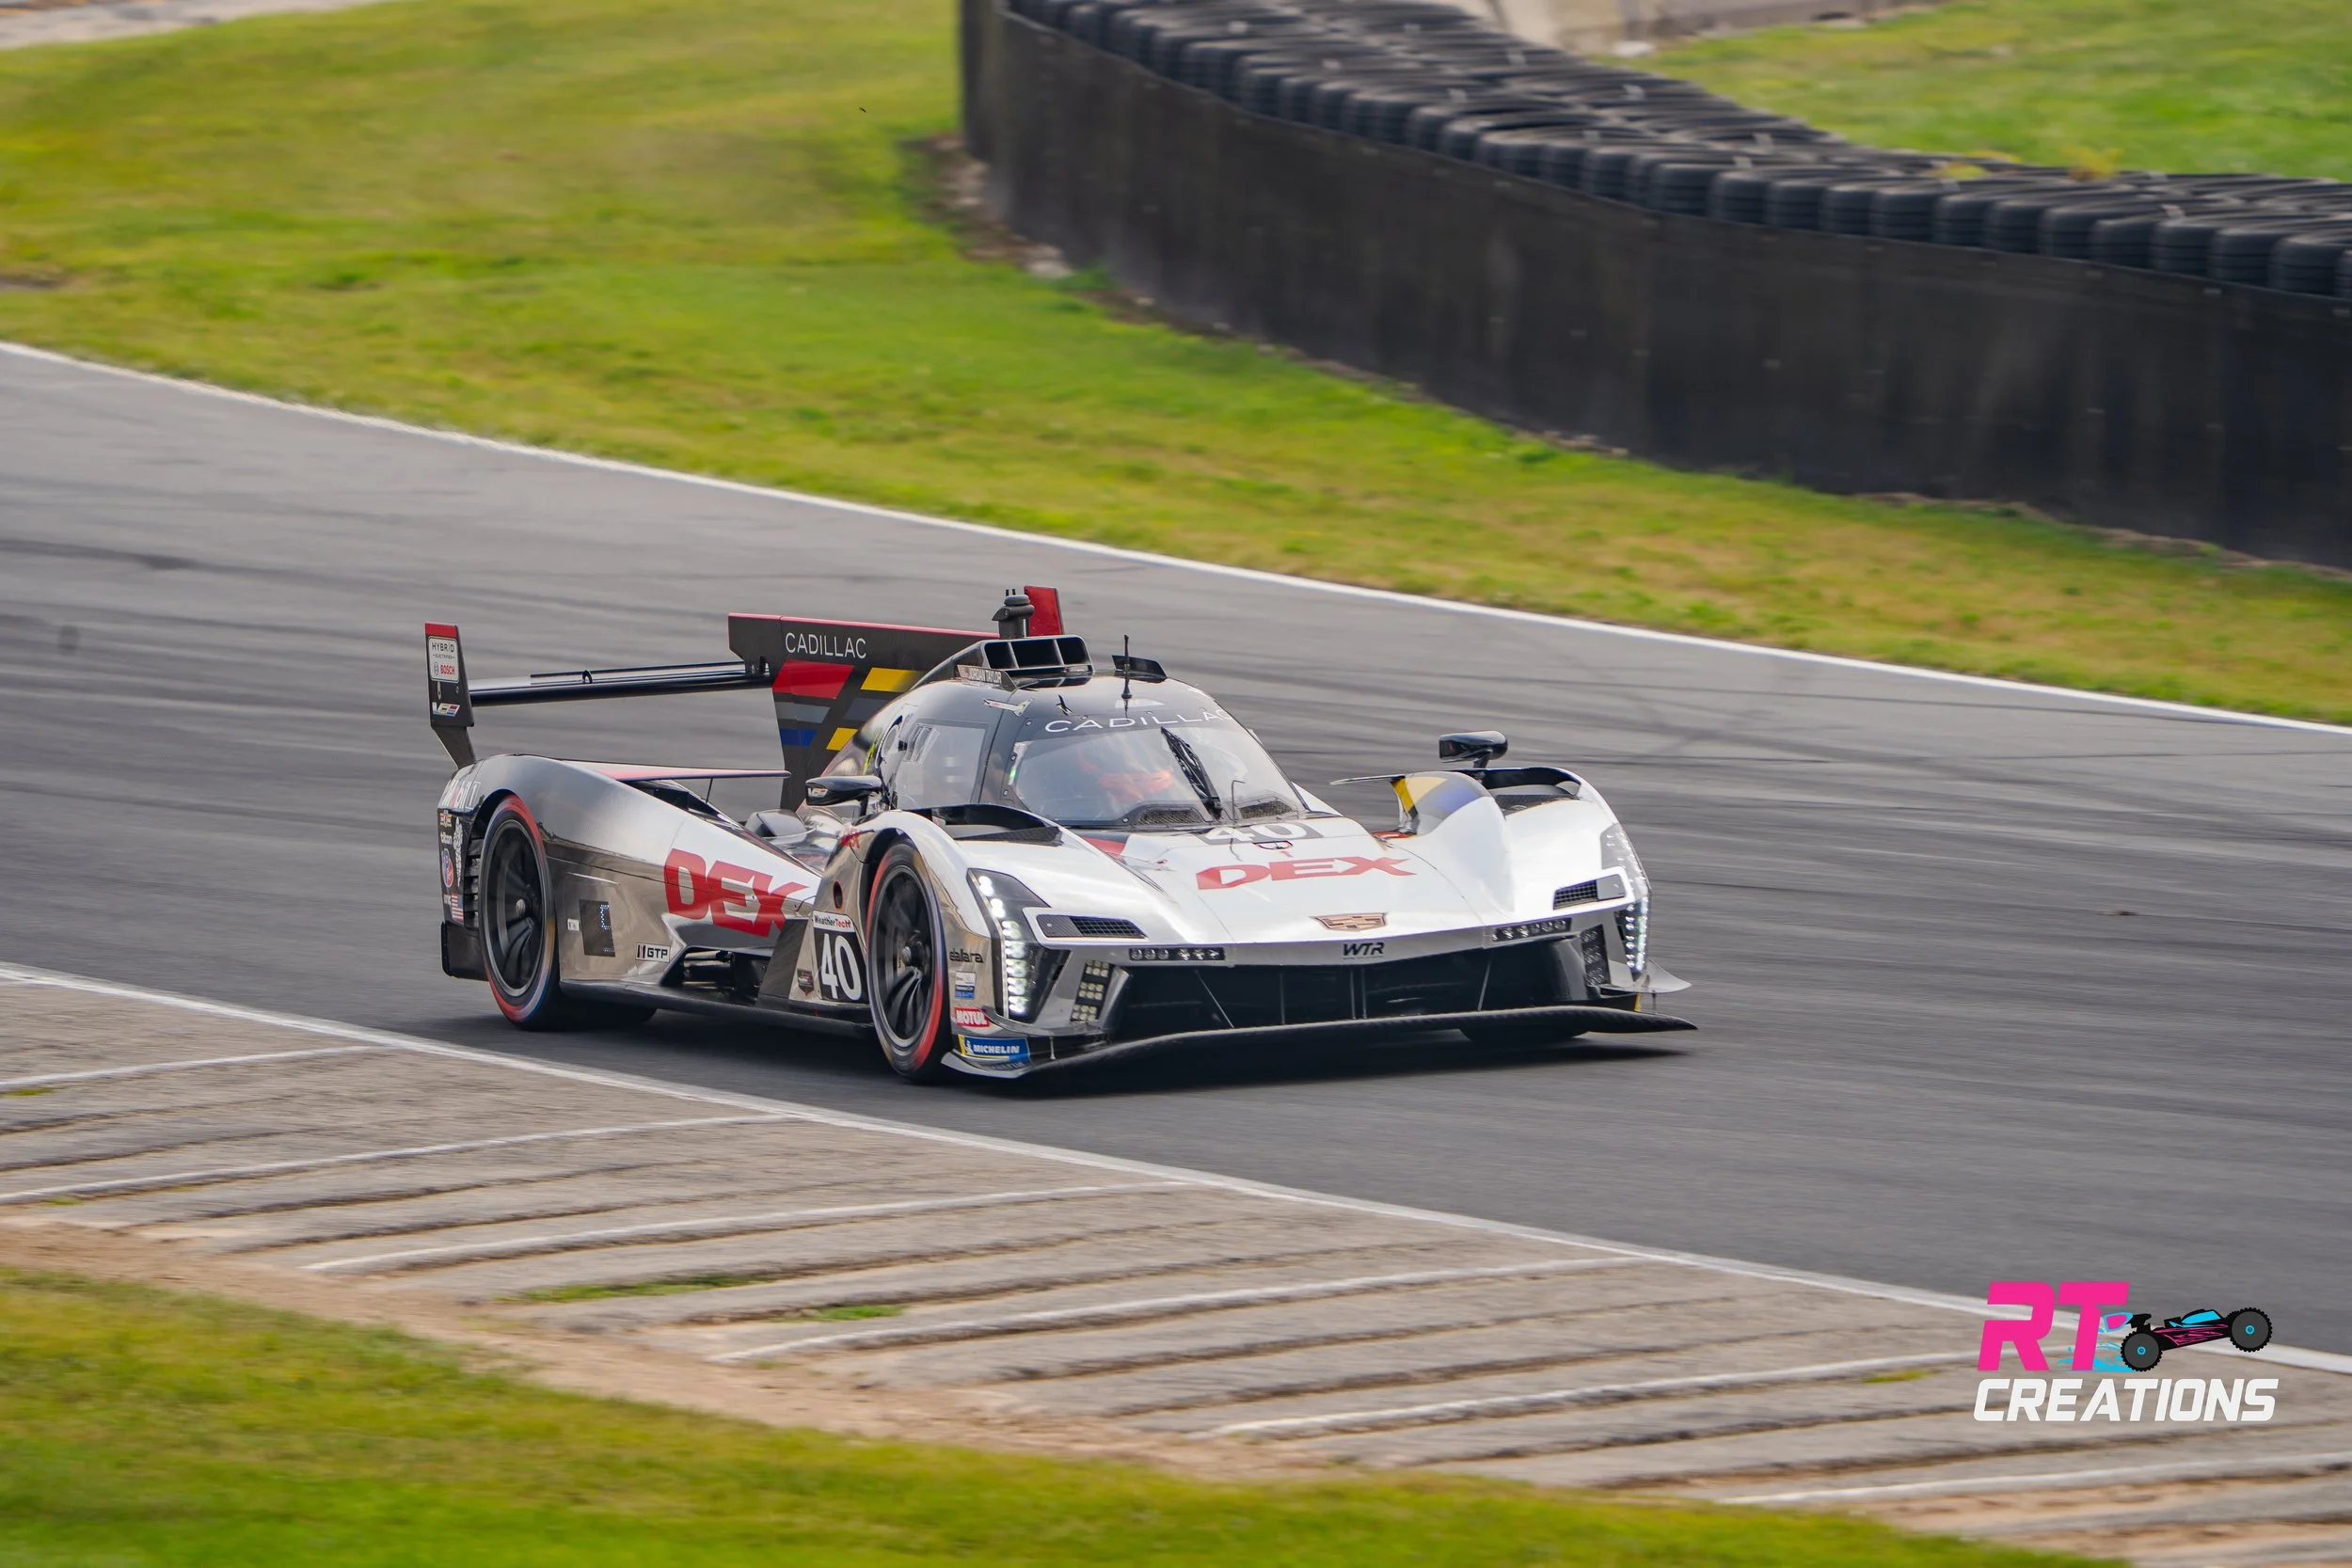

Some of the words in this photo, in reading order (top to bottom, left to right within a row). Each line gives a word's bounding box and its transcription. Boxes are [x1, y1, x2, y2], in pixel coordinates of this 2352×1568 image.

[785, 632, 866, 658] CADILLAC
[439, 664, 455, 675] BOSCH
[1045, 708, 1232, 734] CADILLAC
[1204, 822, 1307, 842] 40
[1196, 856, 1417, 890] DEX
[663, 847, 810, 938] DEX
[814, 915, 851, 928] WeatherTech
[646, 947, 668, 959] GTP
[1343, 942, 1385, 957] WTR
[821, 933, 862, 1000] 40
[956, 1009, 988, 1025] MOTUL
[973, 1044, 1020, 1054] MICHELIN
